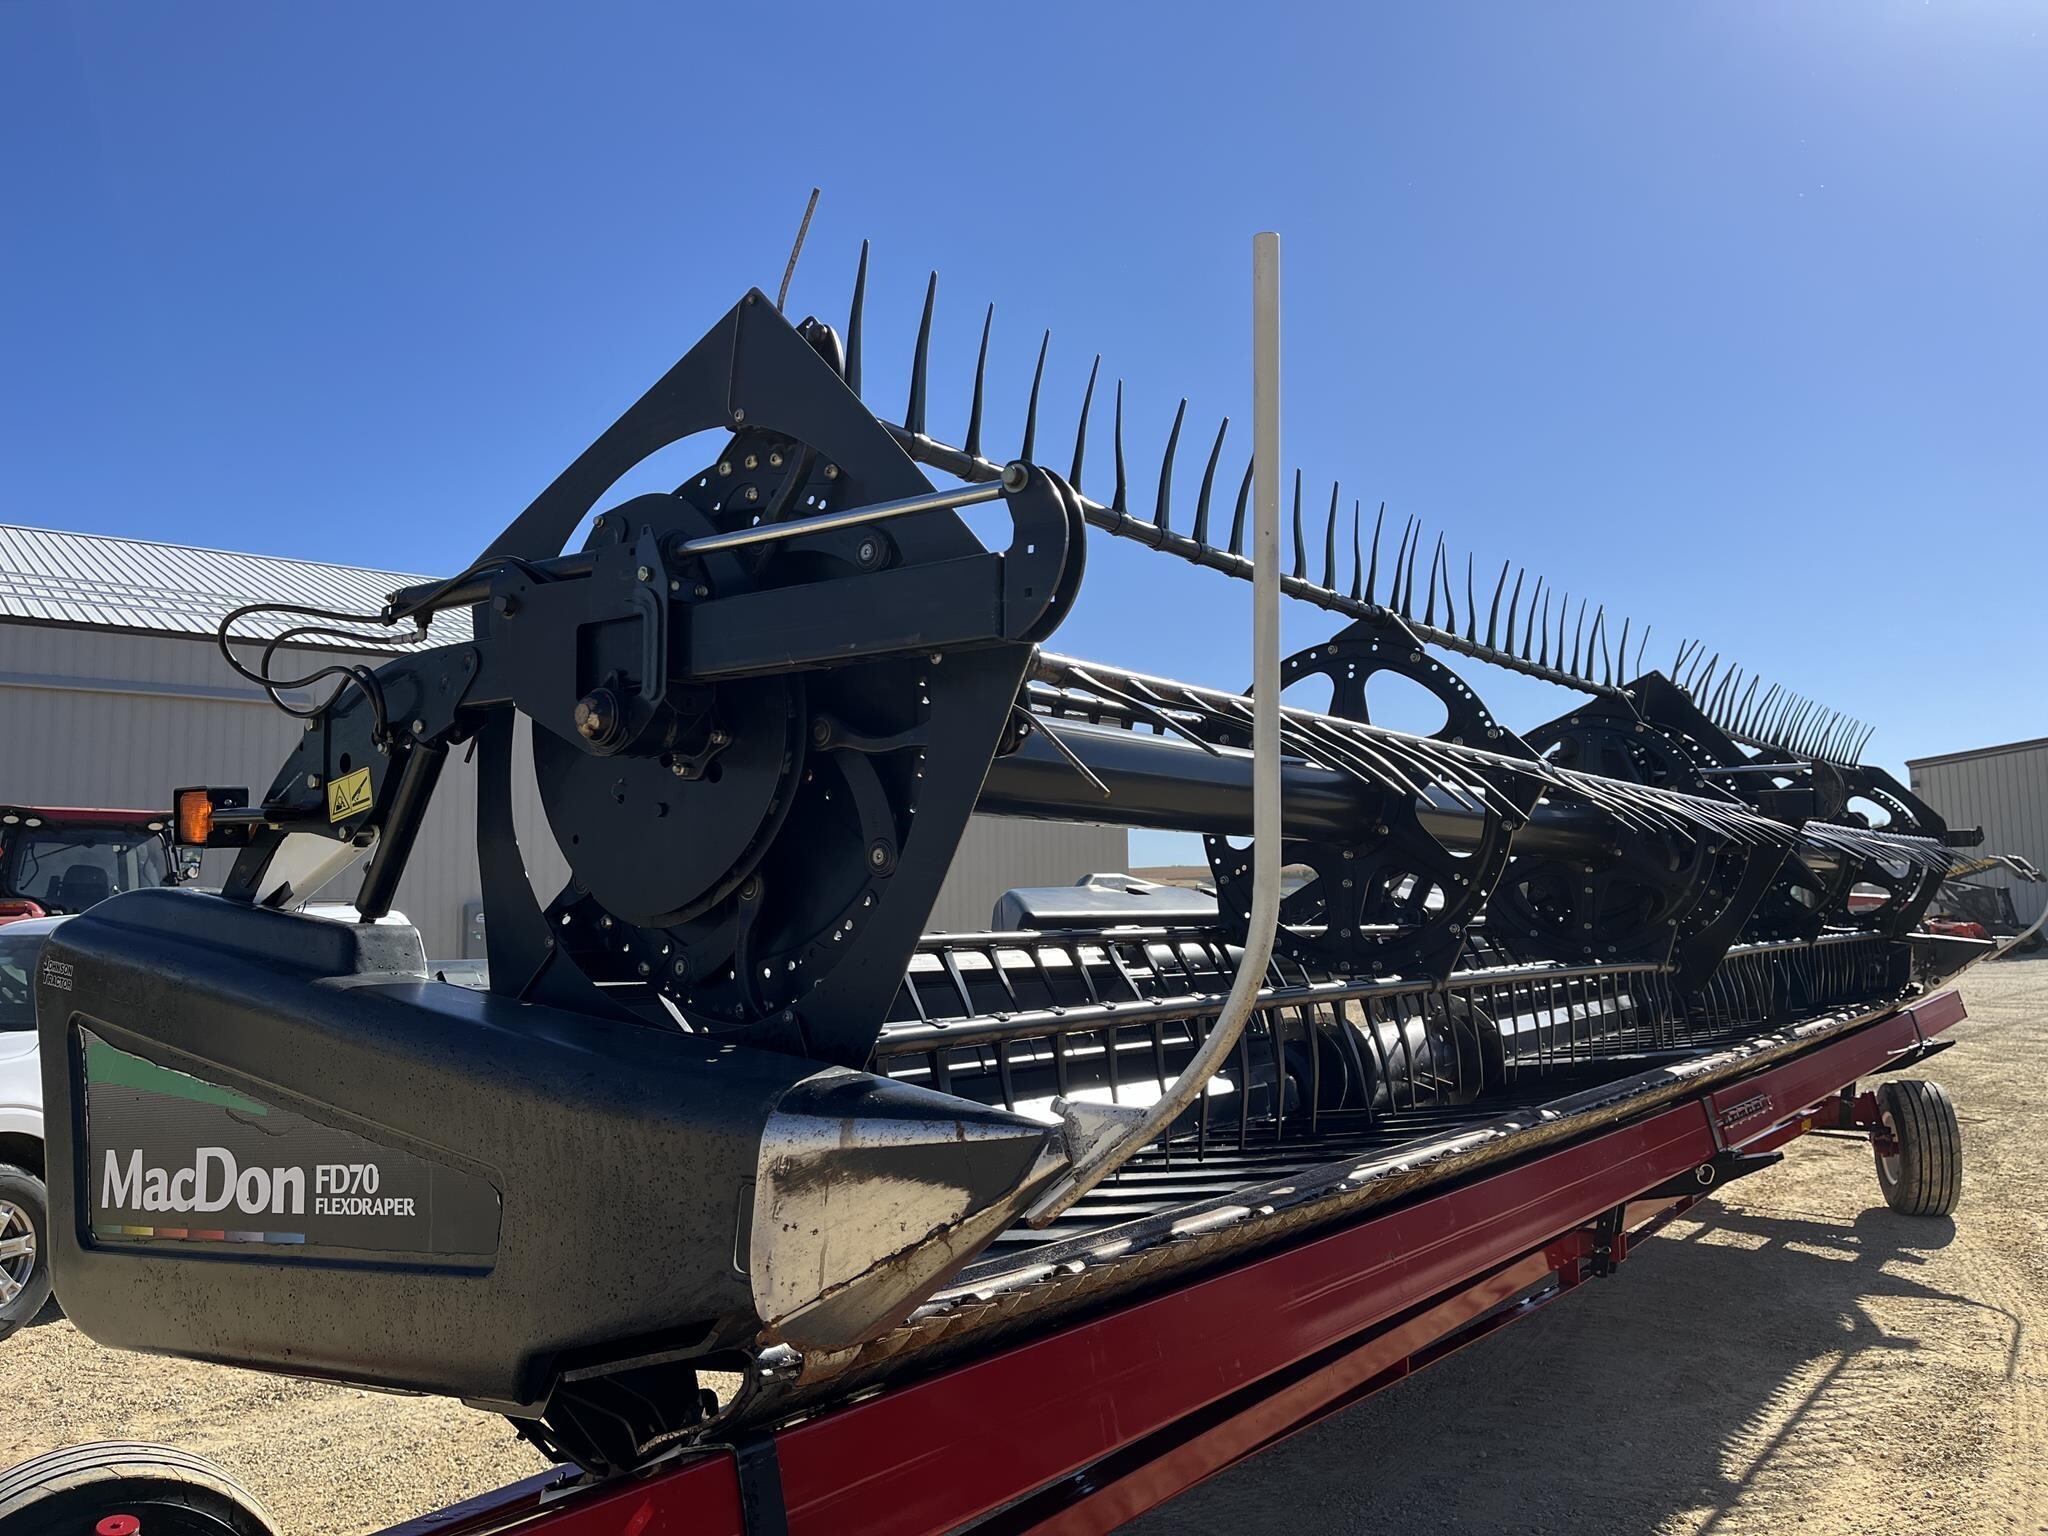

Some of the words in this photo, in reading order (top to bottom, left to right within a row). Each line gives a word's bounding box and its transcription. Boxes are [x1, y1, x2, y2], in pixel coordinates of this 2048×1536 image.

[43, 955, 74, 976] JOHNSON
[43, 972, 72, 991] TRACTOR
[101, 1147, 305, 1215] MacDon
[315, 1164, 380, 1195] FD70
[315, 1198, 416, 1217] FLEXDRAPER
